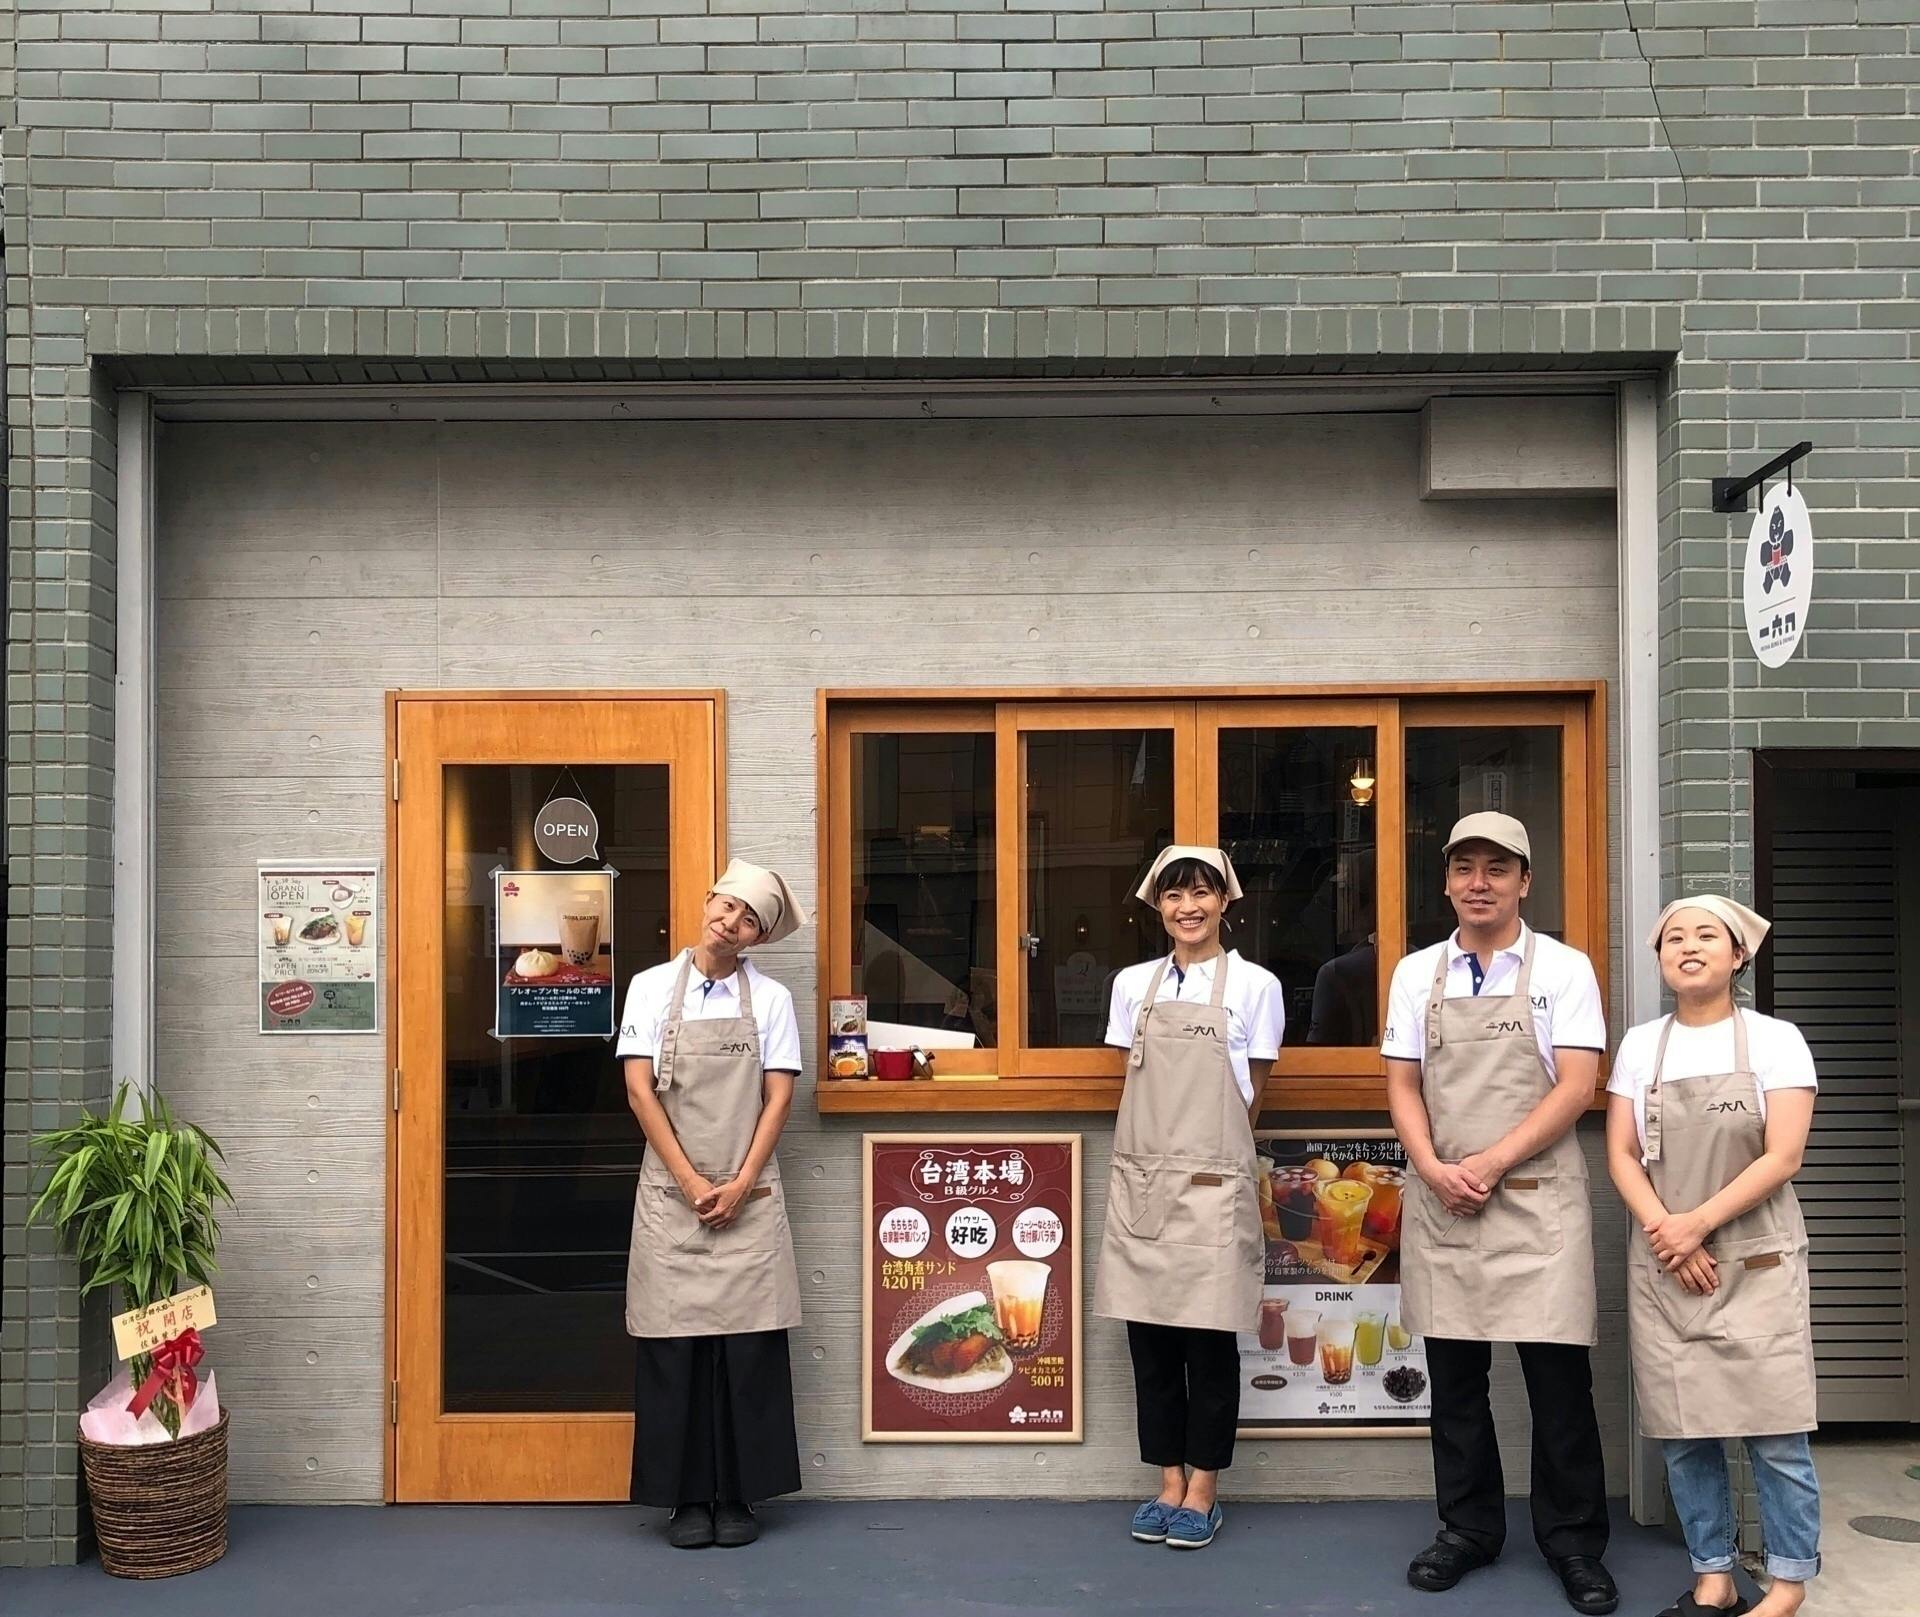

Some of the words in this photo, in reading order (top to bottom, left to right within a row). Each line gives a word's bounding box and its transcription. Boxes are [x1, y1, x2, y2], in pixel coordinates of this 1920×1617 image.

[543, 823, 589, 837] OPEN
[271, 891, 304, 900] OPEN
[1183, 1025, 1216, 1037] 一六八
[1486, 1021, 1523, 1032] 一六八
[720, 1043, 751, 1053] 一六八
[1706, 1101, 1747, 1113] 一六八
[1306, 1142, 1405, 1152] 南国フルーツをたっぷり使
[920, 1159, 1024, 1186] 台湾本場
[891, 1219, 918, 1230] もちもちの
[951, 1226, 988, 1245] 好吃
[882, 1261, 956, 1276] 台湾角煮サンド
[1315, 1291, 1353, 1302] DRINK
